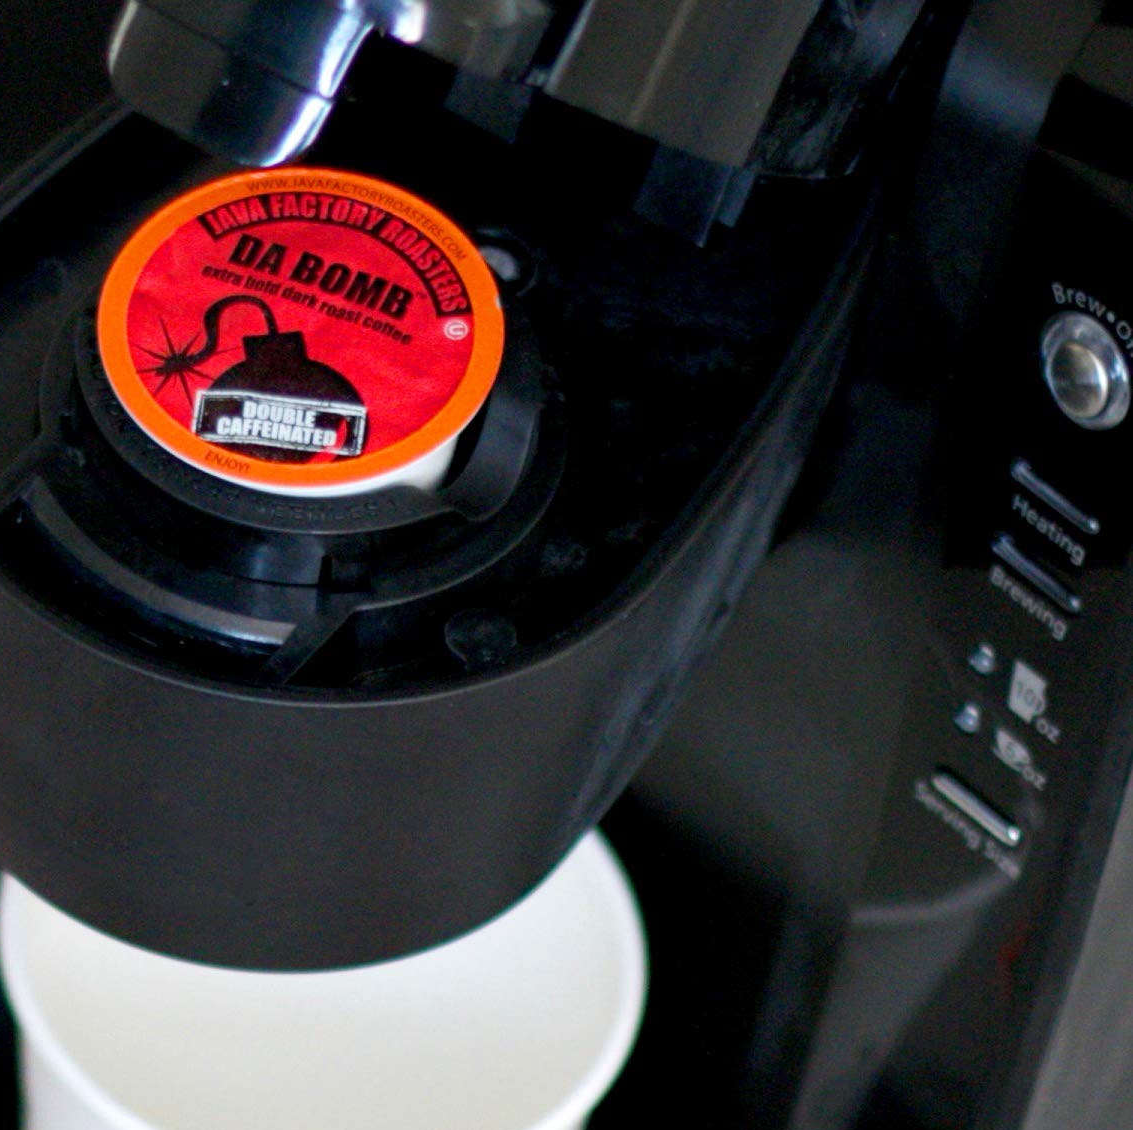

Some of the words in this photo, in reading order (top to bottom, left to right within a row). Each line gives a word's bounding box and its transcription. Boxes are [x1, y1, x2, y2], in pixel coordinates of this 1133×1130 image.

[205, 198, 268, 236] JAVA
[270, 192, 386, 231] FACTORY
[378, 218, 469, 314] ROASTERS
[228, 233, 288, 276] DA
[289, 250, 415, 320] BOMB
[201, 264, 243, 286] extra
[280, 285, 318, 310] dark
[318, 297, 364, 326] roast
[362, 315, 414, 346] coffee
[1051, 281, 1106, 318] Brew
[216, 417, 338, 447] CAFFEINATED
[242, 401, 317, 428] DOUBLE
[203, 449, 251, 474] ENJOY!
[1011, 494, 1085, 567] Heating
